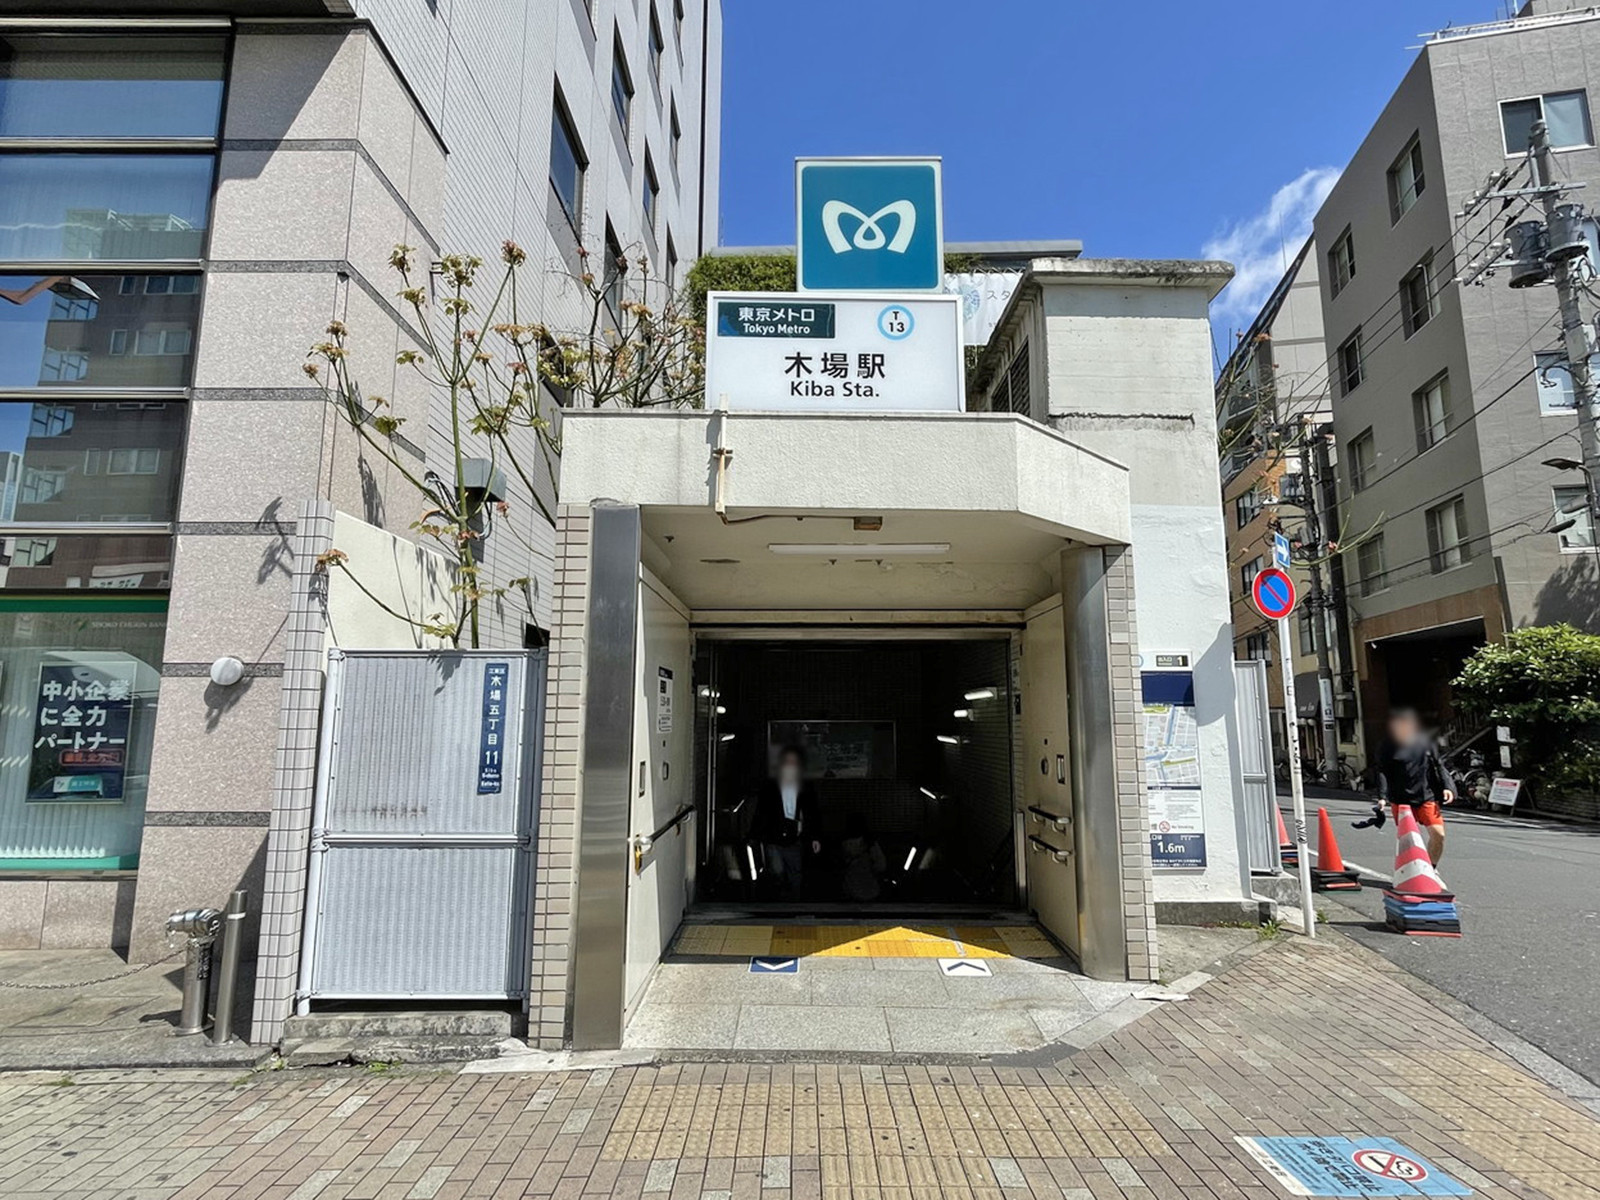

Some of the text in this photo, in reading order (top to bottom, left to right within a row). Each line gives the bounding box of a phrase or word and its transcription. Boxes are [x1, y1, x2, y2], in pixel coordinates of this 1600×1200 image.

[738, 307, 816, 322] 東京メトロ
[892, 311, 899, 320] T
[743, 323, 810, 335] Tokyo Metro
[888, 321, 905, 333] 13
[784, 353, 886, 379] 木場駅
[790, 381, 880, 397] Kiba Sta.
[1177, 656, 1183, 665] 1
[42, 680, 131, 702] 中小企業
[40, 705, 107, 727] に全力
[485, 675, 502, 765] 木場五丁目 11
[35, 731, 125, 753] パートナー
[1157, 841, 1185, 853] 1.6m
